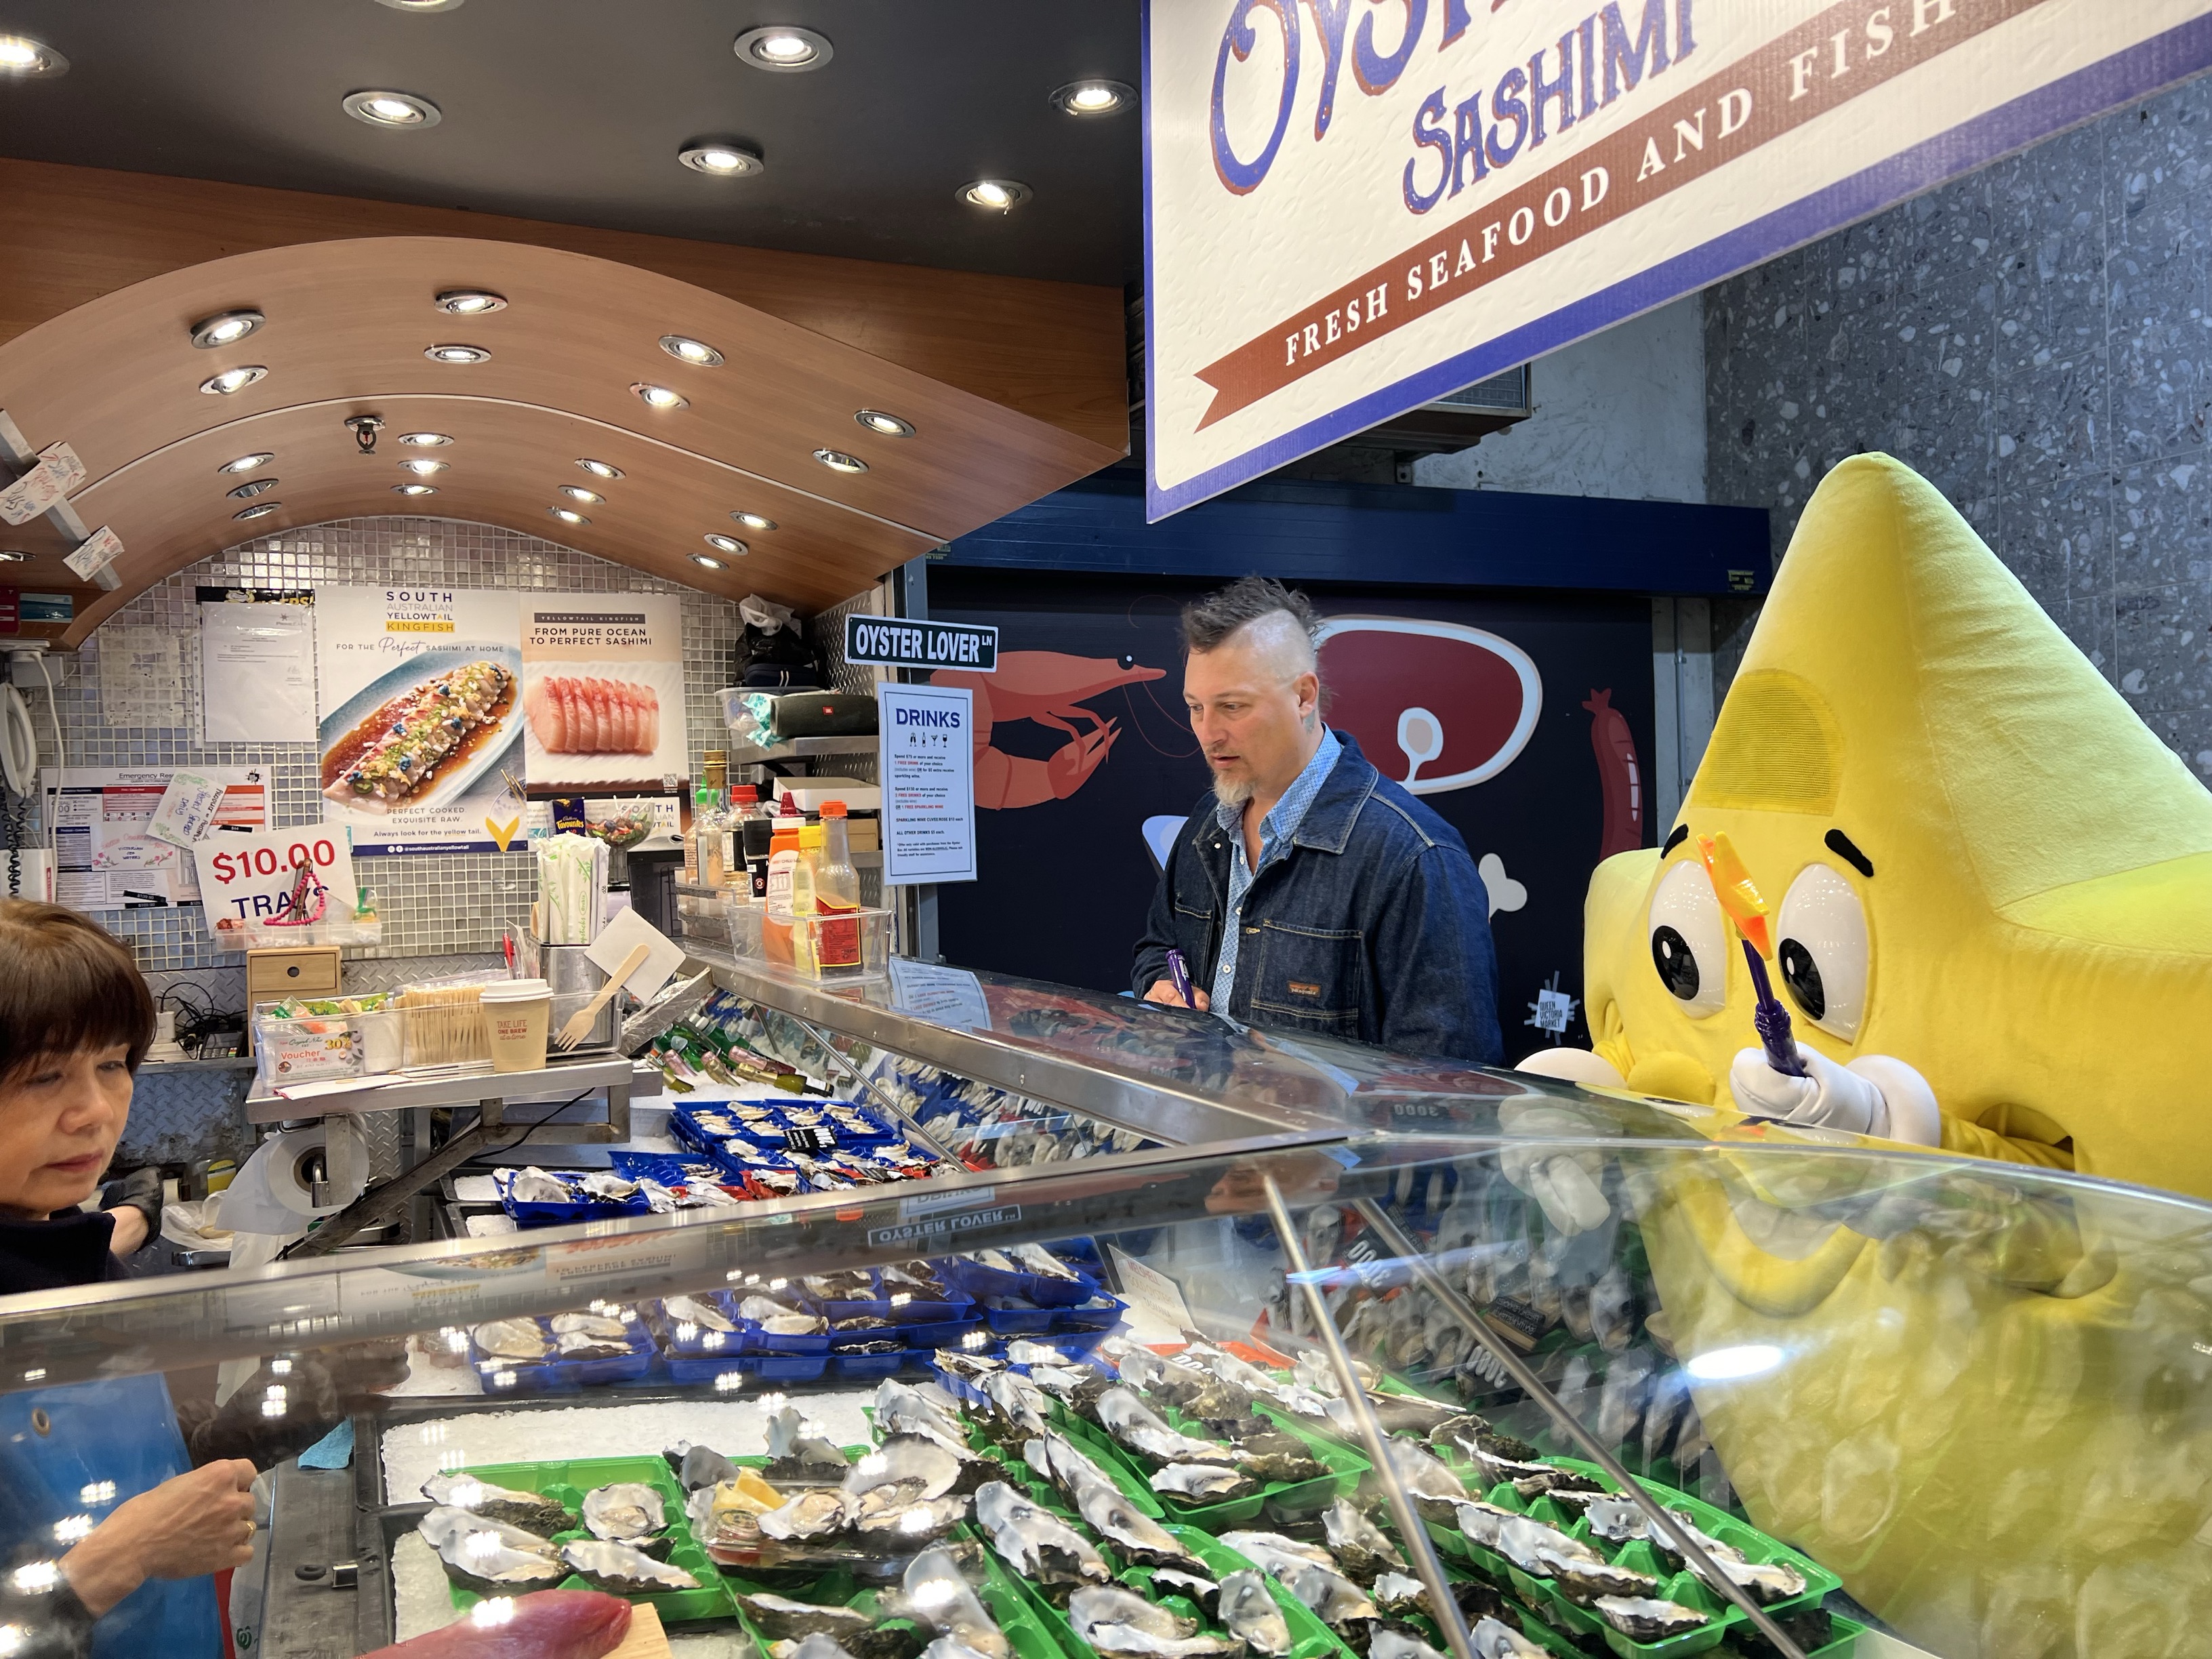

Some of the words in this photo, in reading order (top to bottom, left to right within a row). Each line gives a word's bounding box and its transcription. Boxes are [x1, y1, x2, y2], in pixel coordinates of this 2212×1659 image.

[1403, 0, 1698, 215] SASHIMI
[1286, 283, 1389, 367] FRESH
[1408, 167, 1610, 302] SEAFOOD
[1637, 87, 1753, 182] AND
[1789, 0, 1956, 102] FISH
[386, 592, 452, 602] SOUTH
[387, 603, 453, 611] AUSTRALIAN
[387, 623, 453, 631] KINGFISH
[535, 628, 567, 636] FROM
[378, 636, 426, 657] Perfect
[856, 624, 923, 659] OYSTER
[927, 630, 980, 663] LOVER
[982, 635, 993, 647] LN
[896, 708, 960, 728] DRINKS
[556, 820, 584, 829] Favourites
[212, 840, 335, 884] $10.00
[1540, 1001, 1556, 1010] QUEEN
[1540, 1010, 1563, 1019] VICTORIA
[513, 1019, 527, 1027] LIFE
[1540, 1019, 1560, 1028] MARKET
[325, 1037, 352, 1050] 30%
[281, 1050, 321, 1060] Voucher
